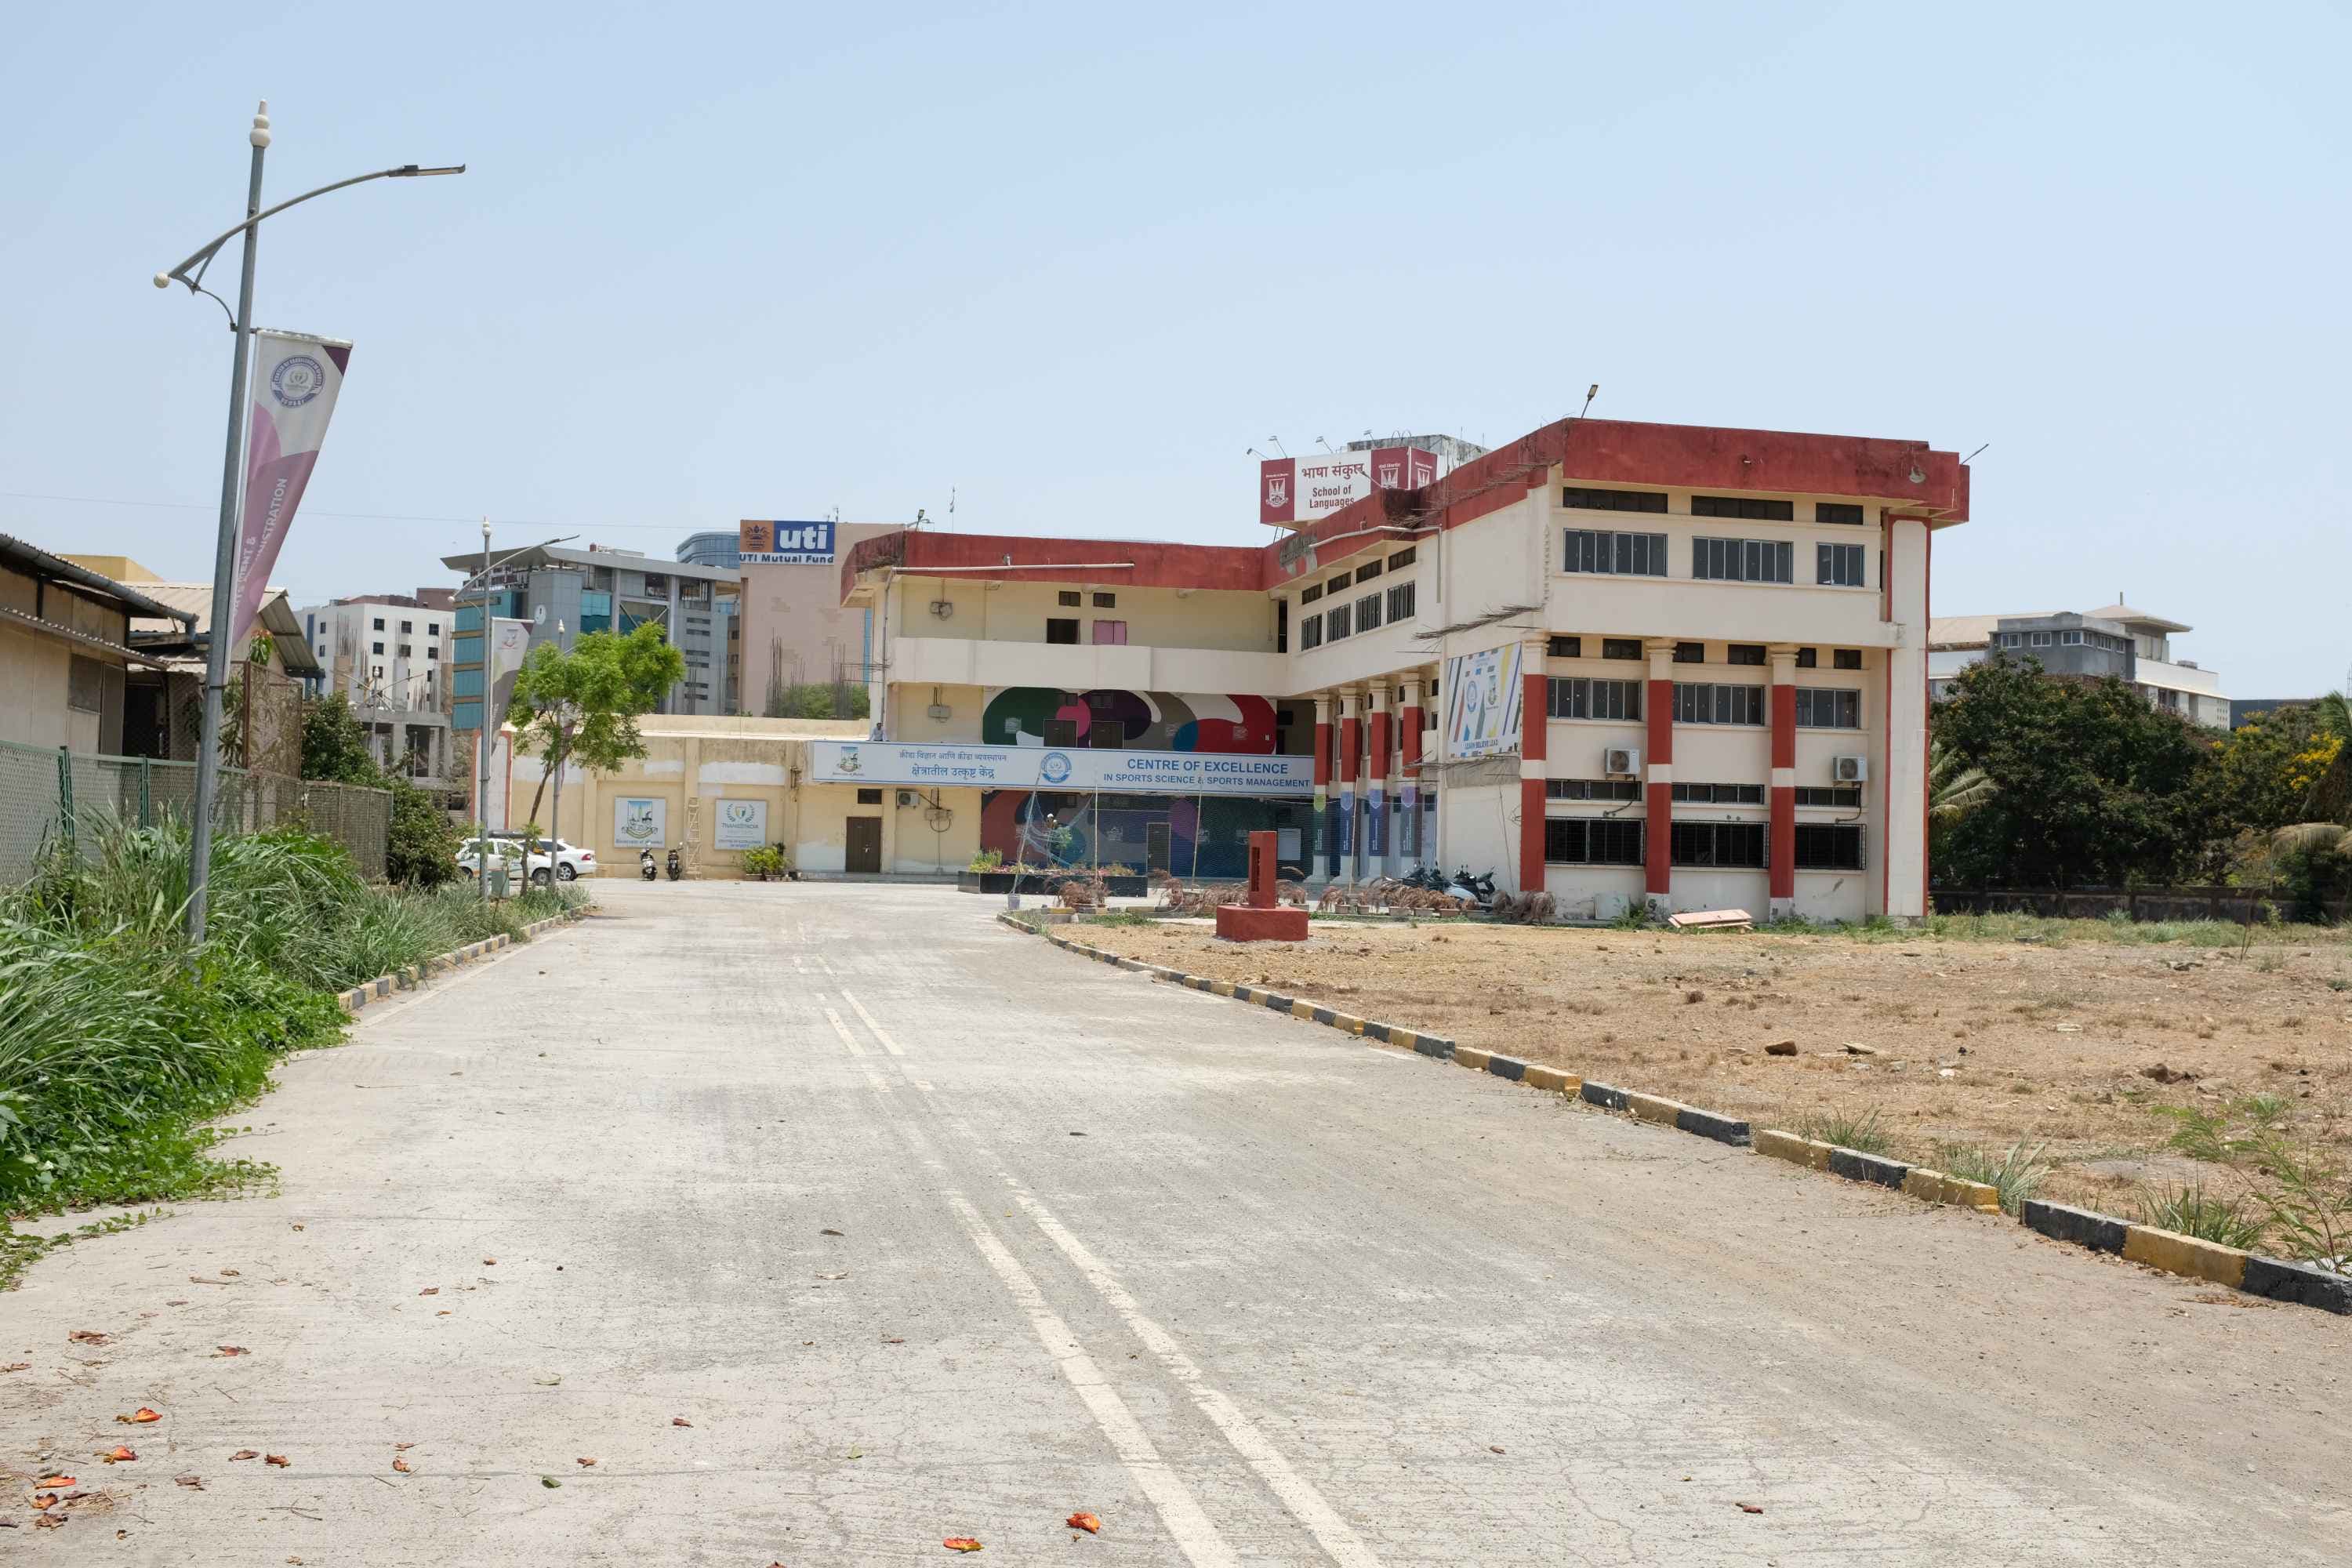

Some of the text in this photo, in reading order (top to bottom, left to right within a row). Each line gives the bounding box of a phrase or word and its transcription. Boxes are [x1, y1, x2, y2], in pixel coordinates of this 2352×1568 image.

[1301, 466, 1327, 479] भाषा
[1332, 462, 1365, 480] संकुल
[1312, 485, 1352, 497] School of
[1309, 497, 1355, 509] Languages
[779, 524, 827, 550] uti
[739, 554, 757, 562] UTI
[761, 554, 801, 563] Mutual
[912, 763, 948, 777] क्षेत्रातील
[978, 764, 995, 779] केंद्र
[1127, 759, 1288, 774] CENTRE OF EXCELLENCE
[1116, 774, 1152, 782] SPORTS
[1155, 775, 1195, 784] SCIENCE
[1246, 778, 1311, 787] MANAGEMENT
